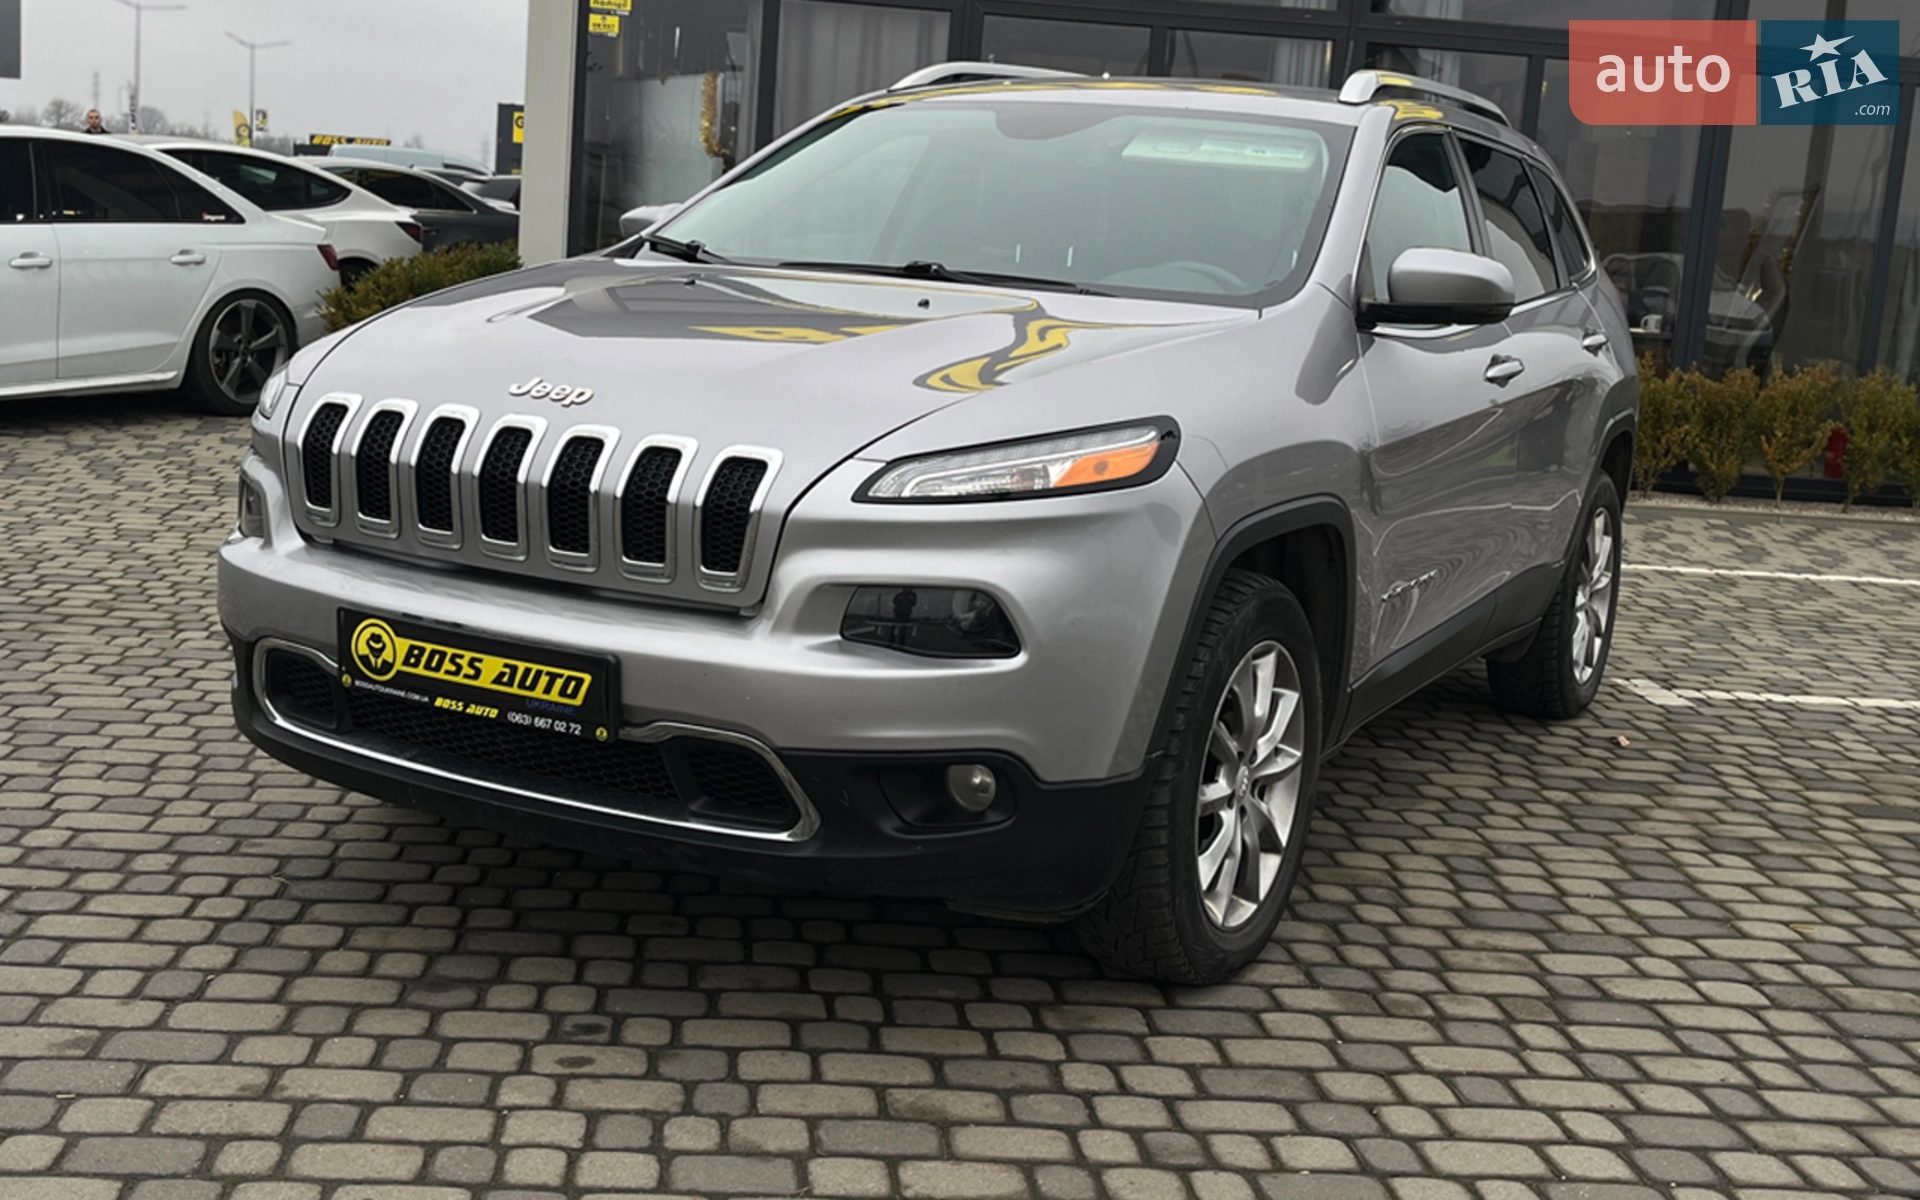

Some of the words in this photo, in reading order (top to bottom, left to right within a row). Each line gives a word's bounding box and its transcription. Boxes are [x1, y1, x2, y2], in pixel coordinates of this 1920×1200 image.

[508, 376, 594, 408] Jeep
[401, 644, 484, 681] BOSS
[491, 662, 586, 700] AUTO
[434, 697, 464, 711] BOSS
[465, 704, 499, 718] AUTO
[525, 698, 576, 716] UKRAINE
[534, 716, 552, 729] 667
[553, 720, 567, 732] 02
[568, 723, 581, 735] 72
